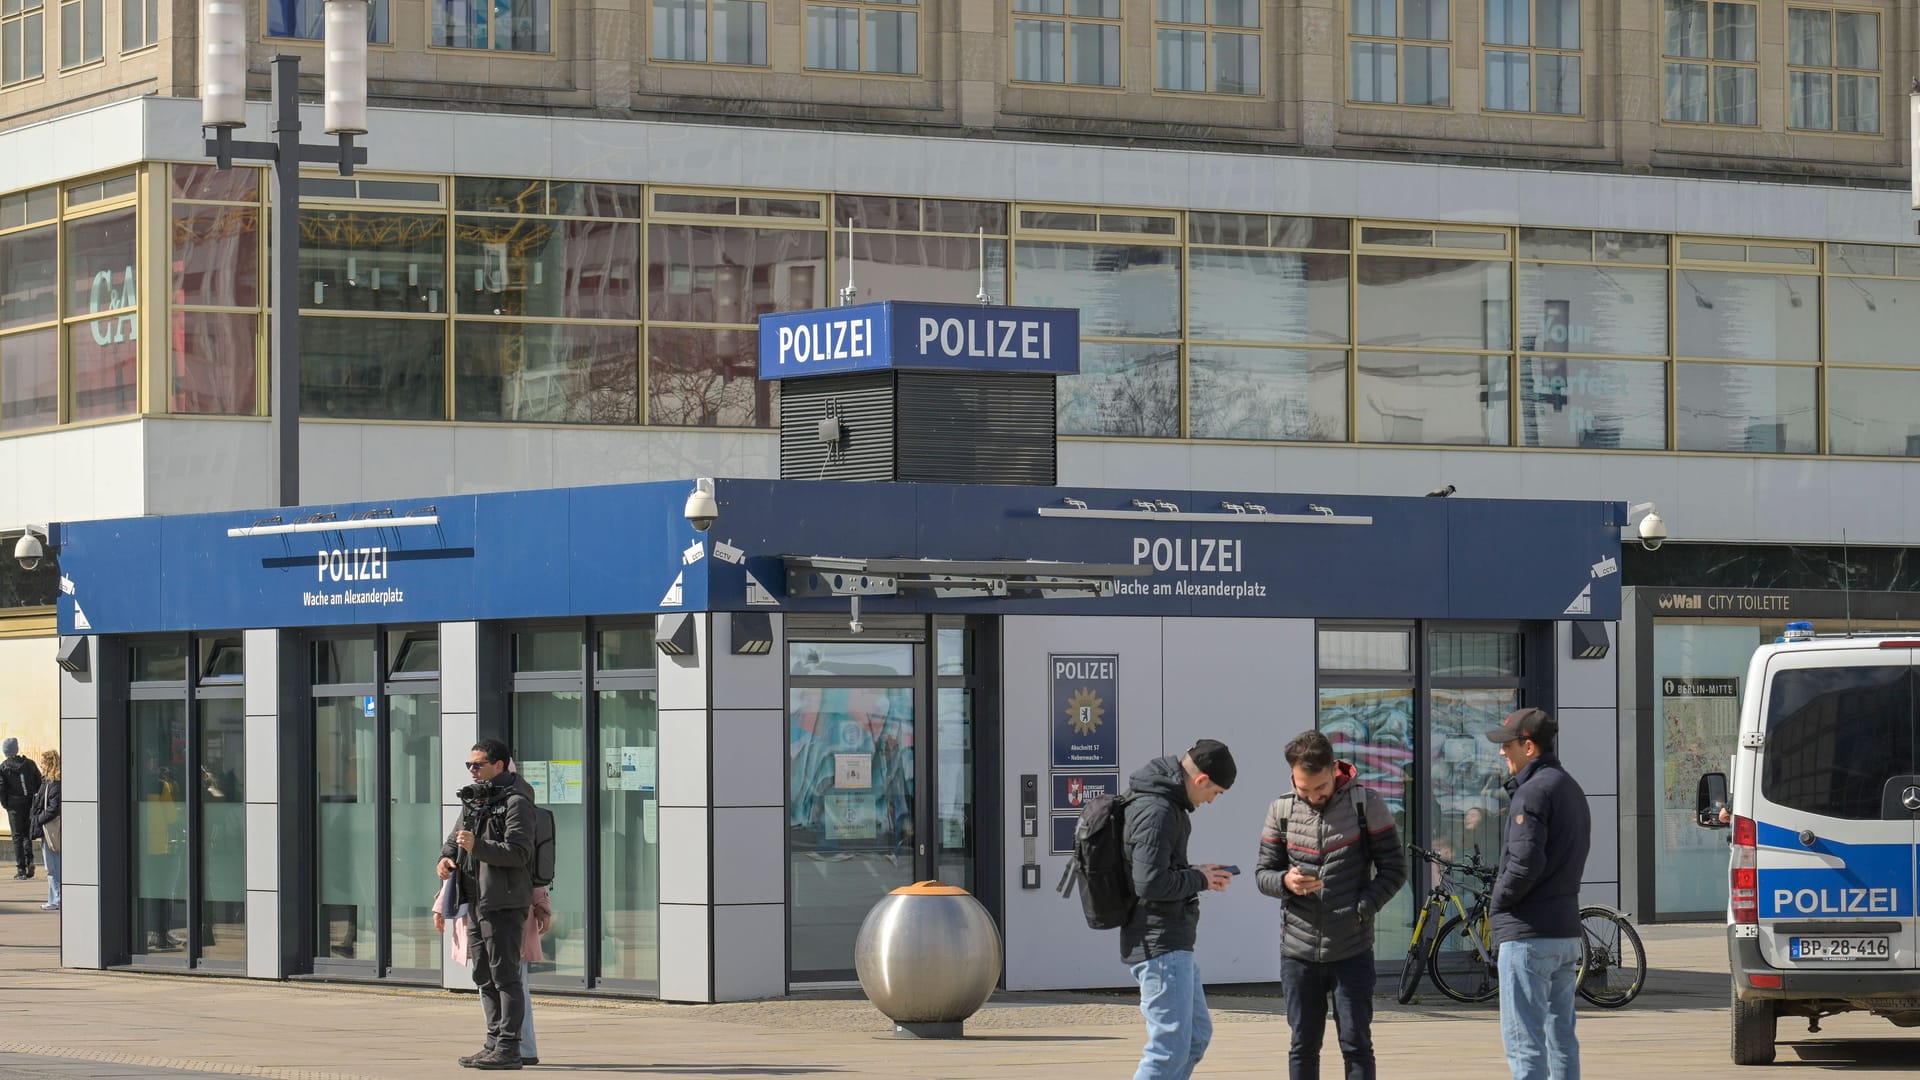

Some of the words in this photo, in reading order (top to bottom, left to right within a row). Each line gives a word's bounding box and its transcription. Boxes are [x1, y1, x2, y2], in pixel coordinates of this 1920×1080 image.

[779, 318, 872, 364] POLIZEI
[919, 317, 1051, 360] POLIZEI
[715, 550, 732, 561] CCTV
[1133, 537, 1242, 572] POLIZEI
[318, 547, 387, 582] POLIZEI
[1603, 565, 1616, 574] CCTV
[303, 590, 329, 606] Wache
[330, 594, 343, 604] am
[344, 587, 404, 606] Alexanderplatz
[1152, 583, 1172, 596] am
[1175, 580, 1267, 599] Alexanderplatz
[1672, 594, 1702, 609] Wall
[1707, 594, 1734, 610] CITY
[1737, 595, 1790, 610] TOILETTE
[1056, 662, 1114, 680] POLIZEI
[1677, 684, 1733, 694] BERLIN-MITTE
[1774, 887, 1897, 913] POLIZEI
[1801, 940, 1821, 955] BP
[1830, 940, 1887, 955] 28-416
